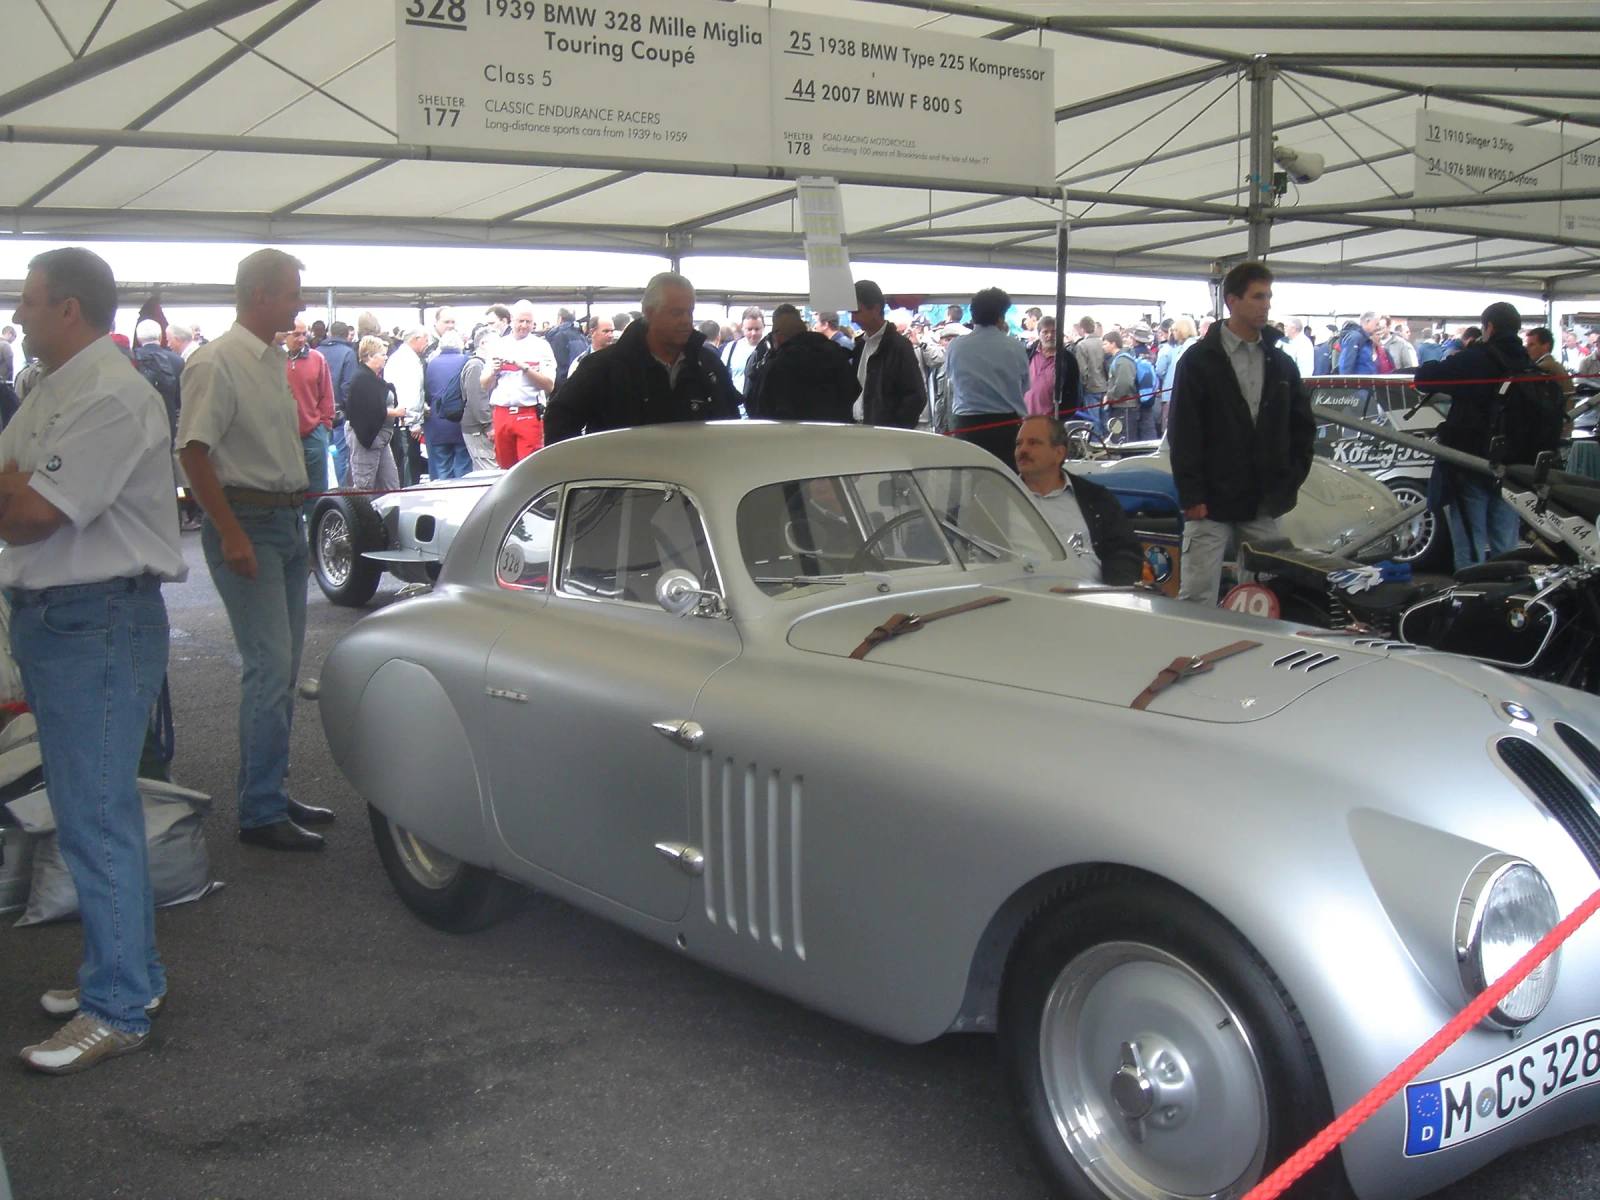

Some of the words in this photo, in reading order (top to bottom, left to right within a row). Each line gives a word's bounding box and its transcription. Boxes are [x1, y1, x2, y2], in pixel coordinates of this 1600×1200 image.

[485, 0, 536, 21] 1939
[544, 4, 597, 28] BMW
[604, 10, 642, 33] 328
[649, 15, 697, 39] Mille
[703, 21, 763, 48] Miglia
[544, 31, 624, 62] Touring
[631, 40, 696, 67] Coupé
[789, 30, 812, 51] 25
[819, 37, 856, 56] 1938
[861, 42, 898, 62] BMW
[902, 48, 935, 69] Type
[939, 53, 965, 71] 225
[969, 57, 1045, 81] Kompressor
[483, 64, 535, 86] Class
[542, 69, 552, 86] 5
[418, 94, 465, 107] SHELTER
[792, 78, 816, 99] 44
[821, 84, 861, 103] 2007
[866, 89, 905, 108] BMW
[910, 94, 918, 109] F
[922, 96, 950, 113] 800
[954, 99, 963, 114] S
[423, 107, 461, 127] 177
[484, 99, 535, 116] CLASSIC
[538, 104, 614, 121] ENDURANCE
[617, 110, 661, 125] RACERS
[485, 118, 551, 133] Long-distance
[552, 123, 581, 136] sports
[582, 126, 601, 137] cars
[602, 126, 625, 138] from
[628, 128, 651, 140] 1939
[652, 130, 662, 141] to
[664, 130, 689, 142] 1959
[783, 131, 814, 141] SHELTER
[1428, 124, 1441, 139] 12
[1443, 129, 1464, 144] 1910
[1465, 133, 1491, 150] Singer
[787, 140, 811, 156] 178
[1428, 157, 1441, 173] 34
[1443, 161, 1464, 176] 1976
[1466, 163, 1487, 179] BMW
[502, 552, 520, 574] 328
[1444, 1081, 1472, 1139] M
[1496, 1055, 1536, 1119] CS
[1542, 1029, 1600, 1096] 328
[1421, 1126, 1434, 1141] D
